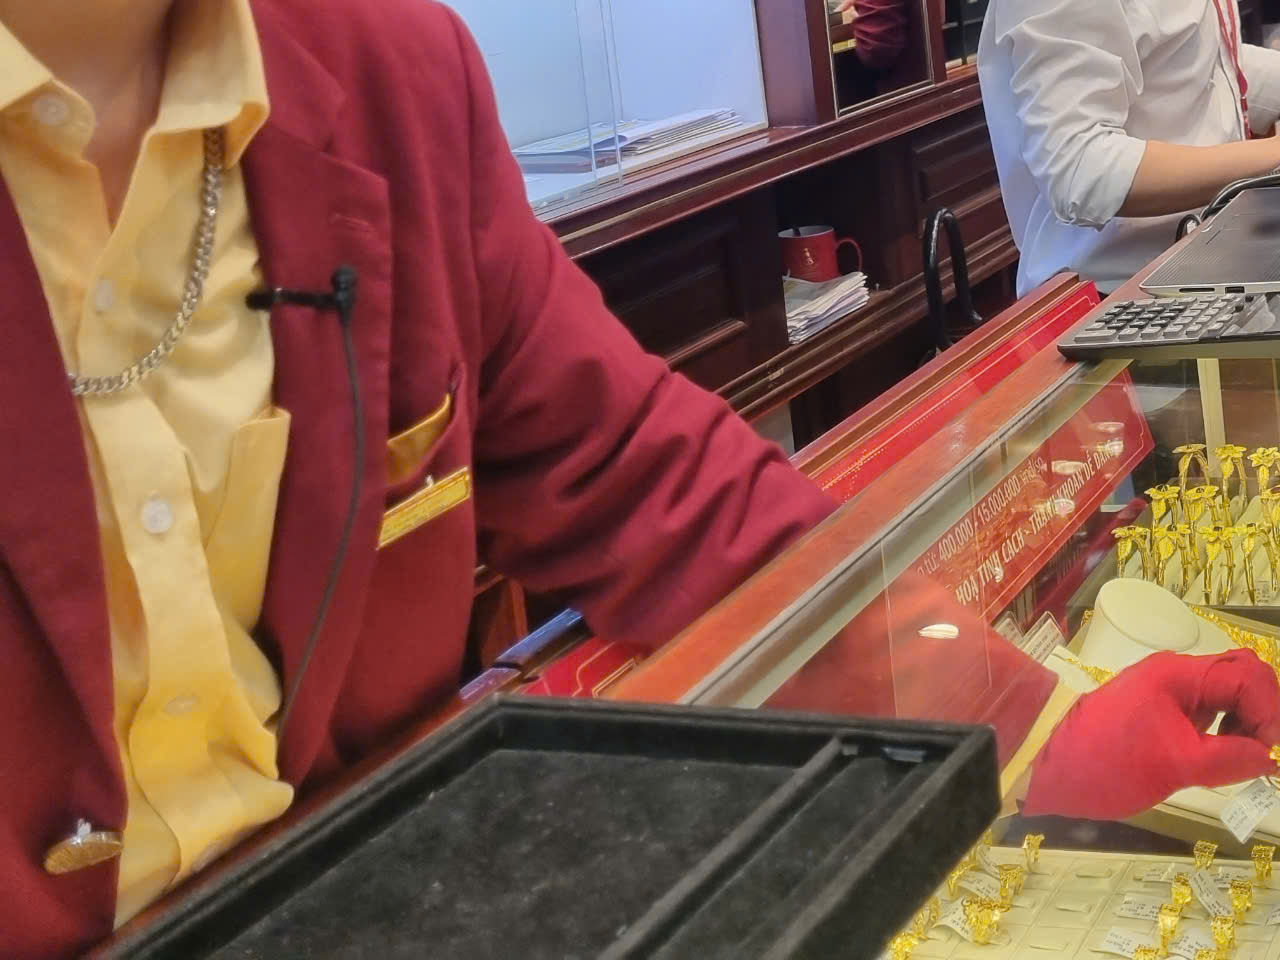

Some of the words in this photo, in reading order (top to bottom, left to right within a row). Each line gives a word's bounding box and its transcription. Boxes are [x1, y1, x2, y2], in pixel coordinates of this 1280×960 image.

[938, 518, 974, 562] 400.000
[978, 474, 1021, 525] 15.000.000
[1001, 528, 1025, 563] CÁCH
